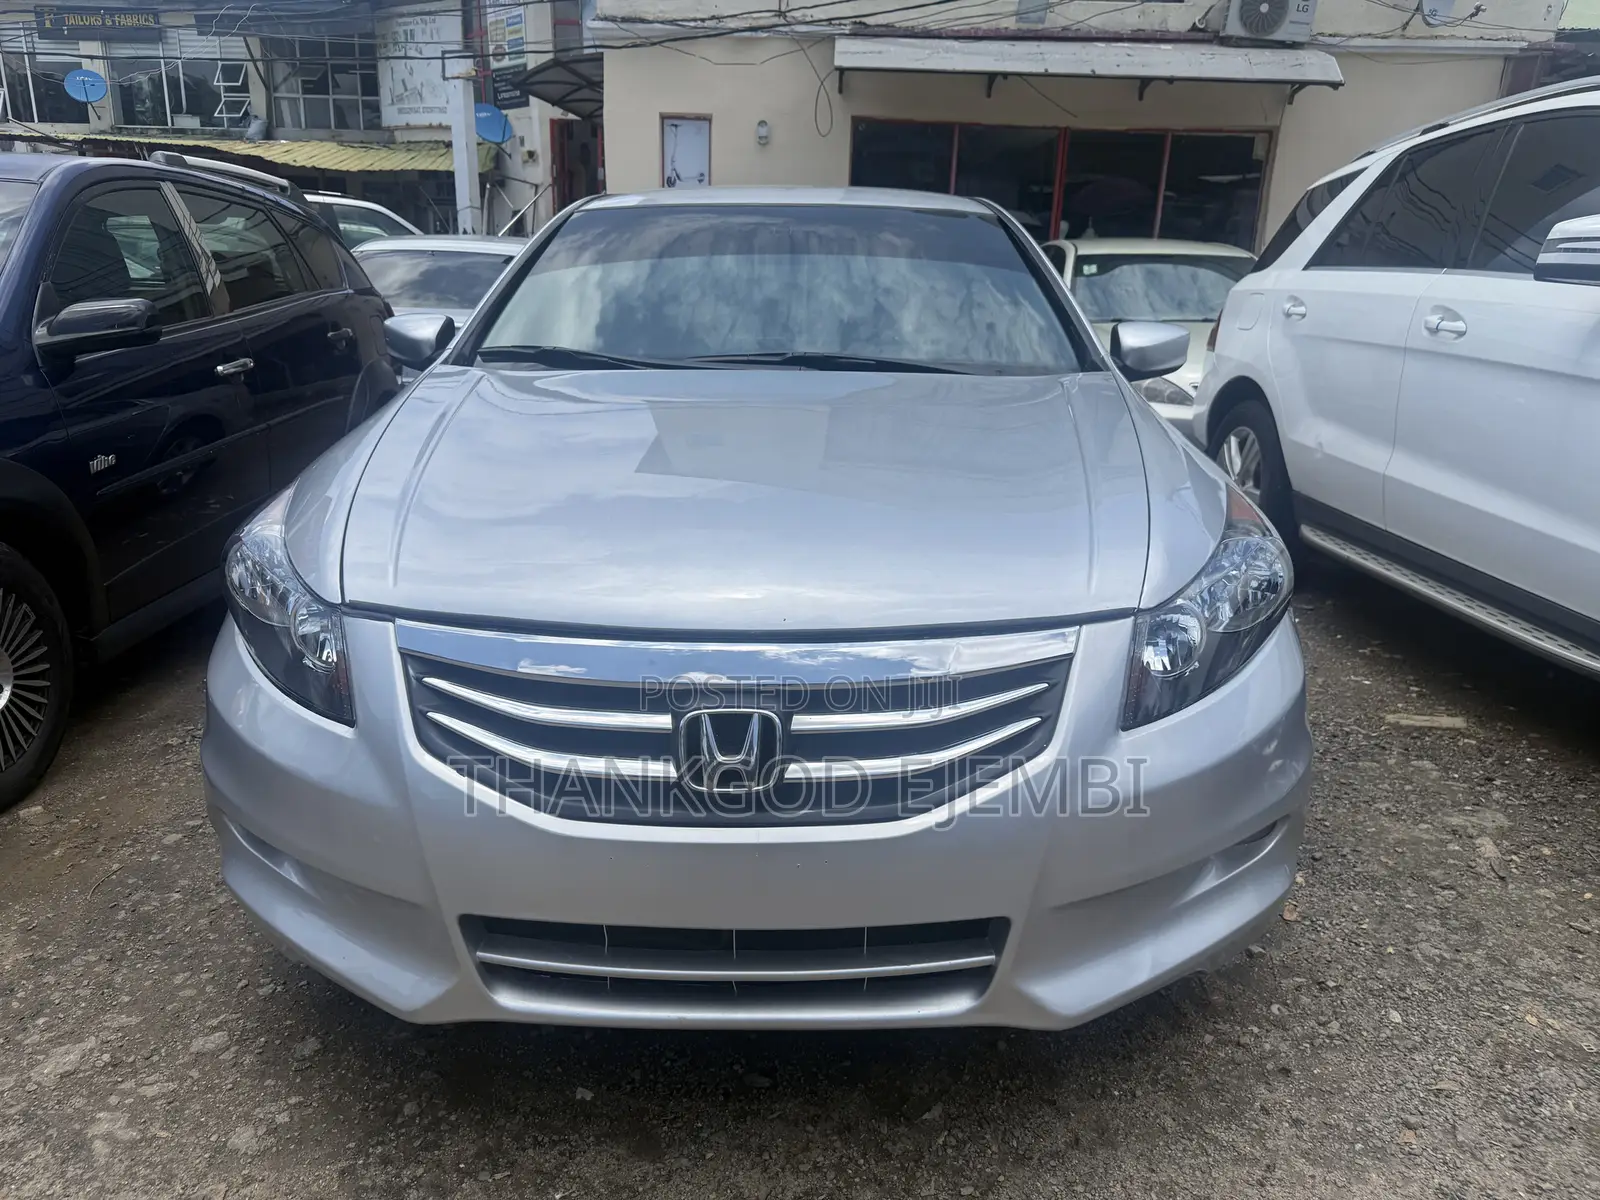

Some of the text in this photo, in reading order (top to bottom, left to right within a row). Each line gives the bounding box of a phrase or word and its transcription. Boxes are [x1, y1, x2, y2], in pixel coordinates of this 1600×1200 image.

[1296, 3, 1310, 13] LG
[64, 13, 155, 27] TAILORS & FABRICS
